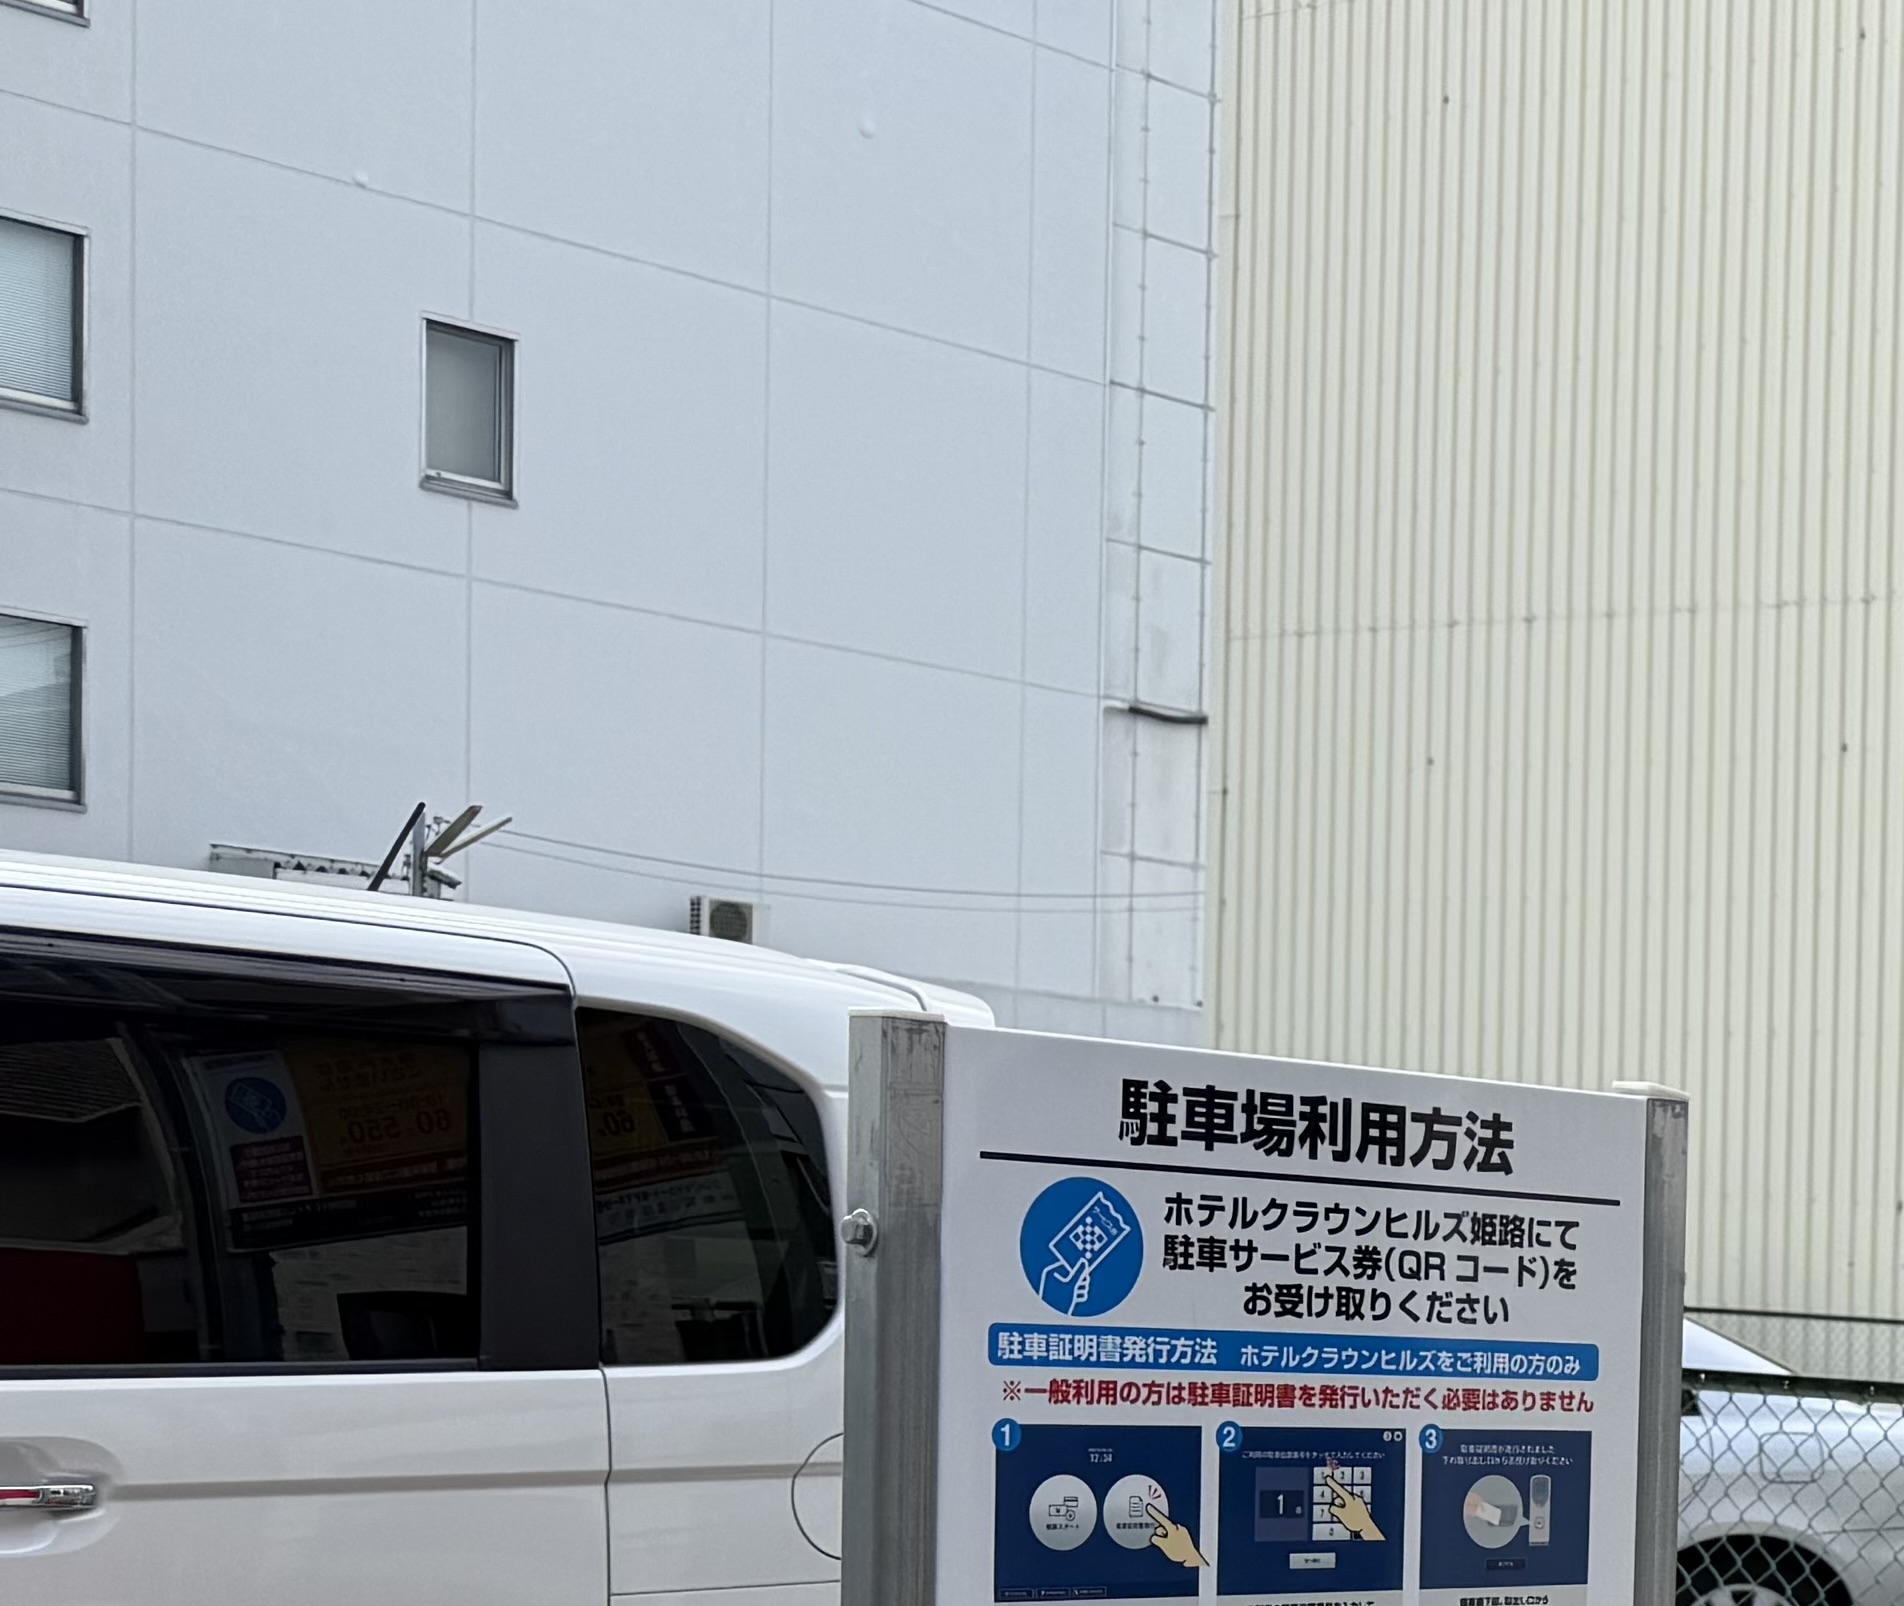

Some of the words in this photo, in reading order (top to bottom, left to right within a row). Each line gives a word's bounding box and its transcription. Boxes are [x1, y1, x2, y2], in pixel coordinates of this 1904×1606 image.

[1117, 1078, 1515, 1176] 駐車場利用方法
[1164, 1192, 1580, 1249] ホテルクラウンヒルズ姫路にて
[1243, 1284, 1510, 1325] お受け取りください
[997, 1331, 1218, 1365] 駐車証明書発行方法
[1240, 1345, 1580, 1376] ホテルクラウンヒルズをご利用の方のみ
[1001, 1378, 1595, 1415] ※一般利用の方は駐車証明書を発行いただく必要はありません
